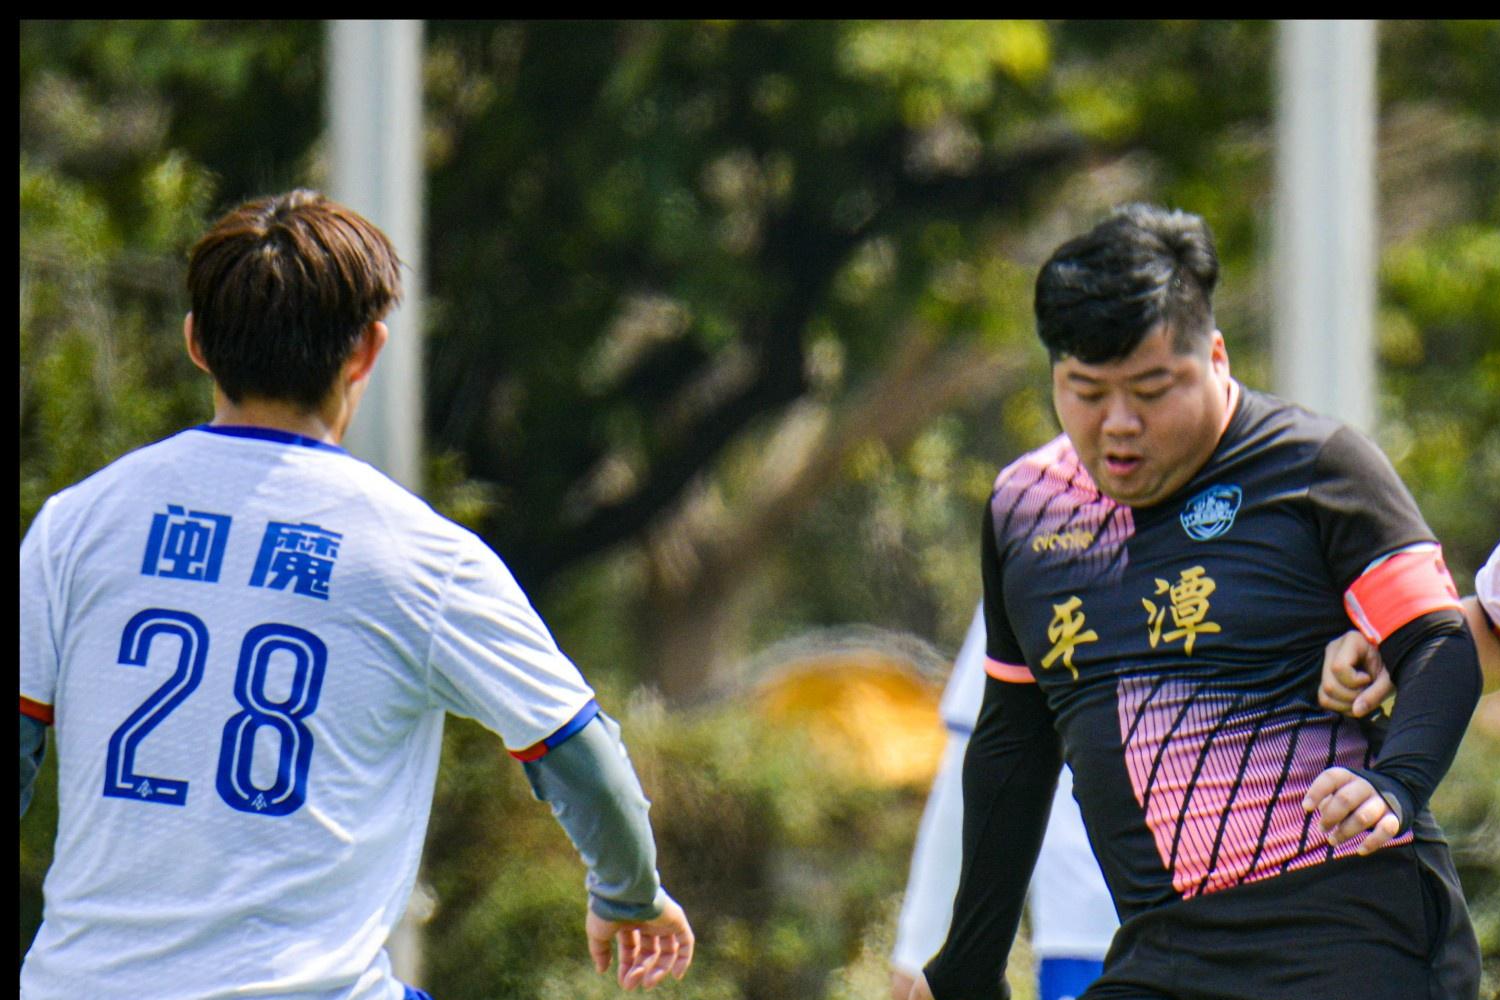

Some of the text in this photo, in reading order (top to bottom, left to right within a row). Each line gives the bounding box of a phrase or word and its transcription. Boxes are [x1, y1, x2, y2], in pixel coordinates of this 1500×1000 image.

[140, 504, 343, 600] 闽魔
[1040, 565, 1222, 681] 平潭
[102, 607, 328, 817] 28
